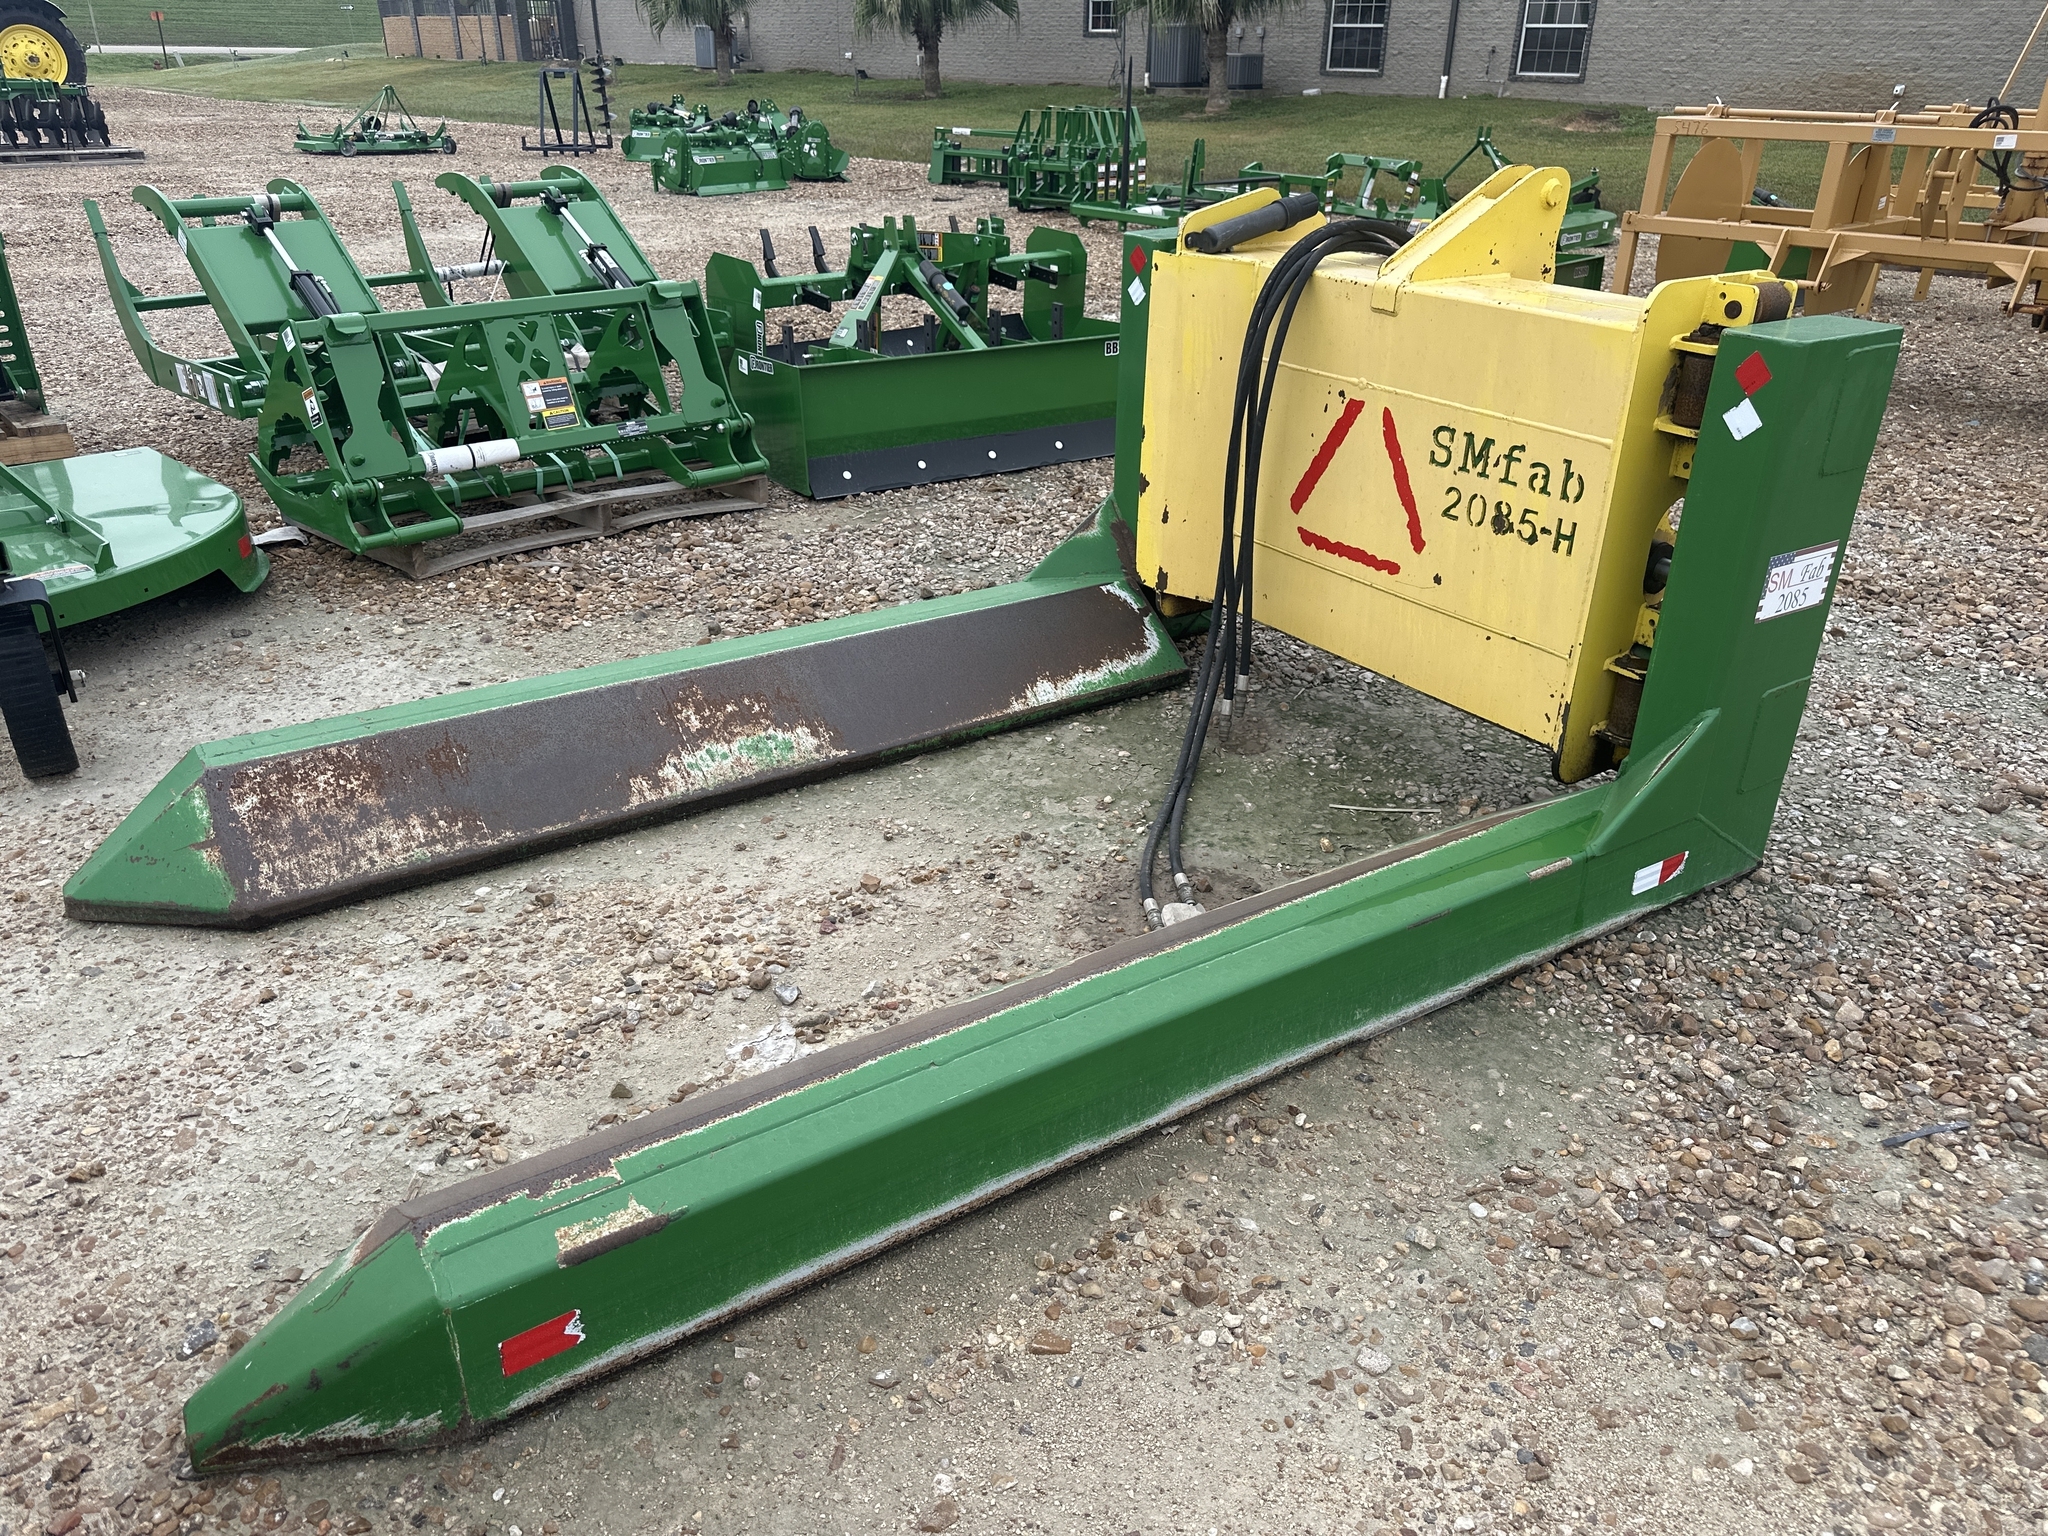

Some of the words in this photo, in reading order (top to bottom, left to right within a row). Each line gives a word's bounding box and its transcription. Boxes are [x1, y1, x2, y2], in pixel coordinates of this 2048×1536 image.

[1429, 425, 1585, 504] SMfab
[1441, 486, 1578, 557] 2085-H
[1768, 568, 1794, 594] SM
[1800, 557, 1827, 582] Fab
[1775, 587, 1809, 613] 2085
